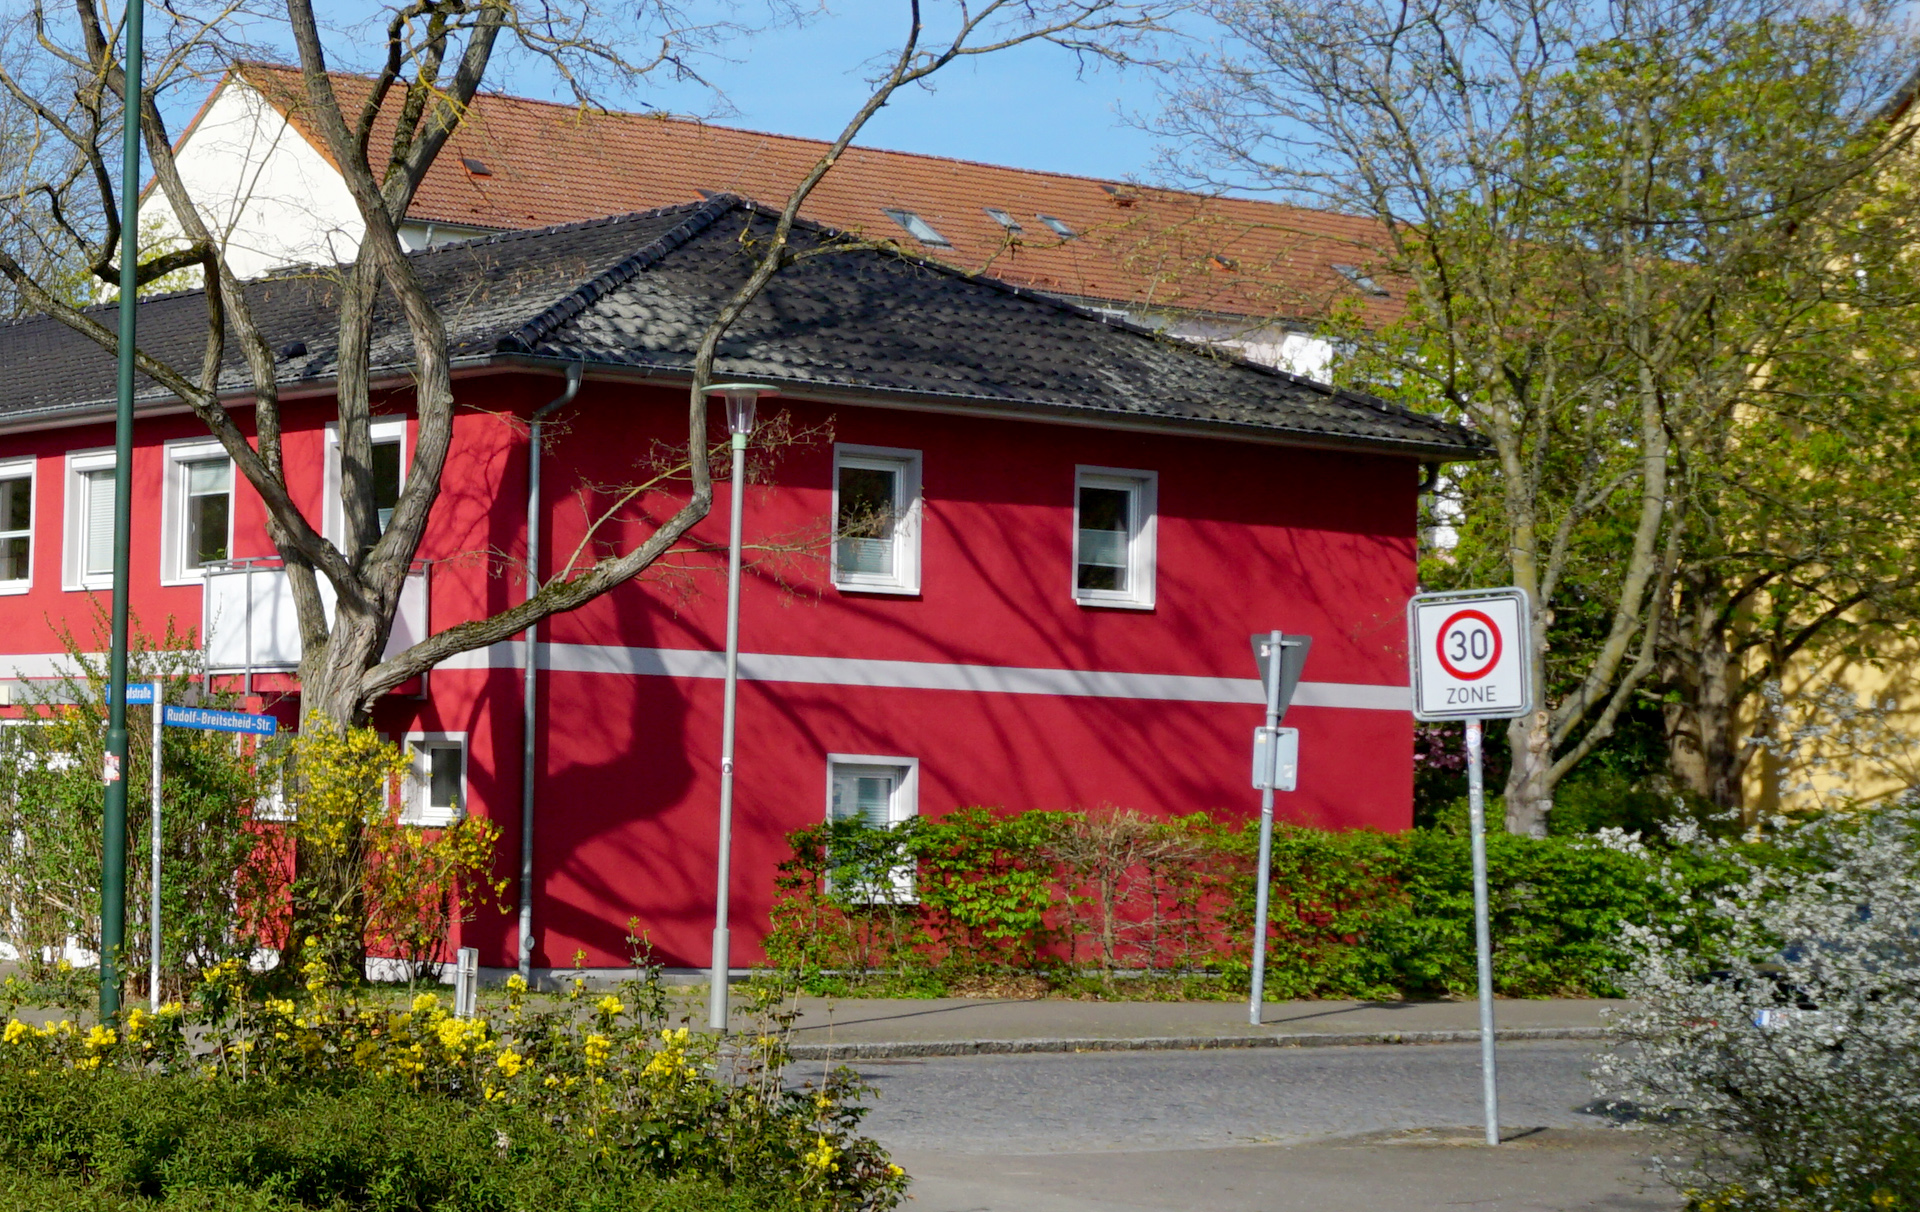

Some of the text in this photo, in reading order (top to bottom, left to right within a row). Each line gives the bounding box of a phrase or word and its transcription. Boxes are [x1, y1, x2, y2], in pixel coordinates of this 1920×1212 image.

[1450, 630, 1488, 662] 30
[1446, 685, 1497, 705] ZONE
[166, 708, 272, 731] Rudolf-Breitscheid-Str.
